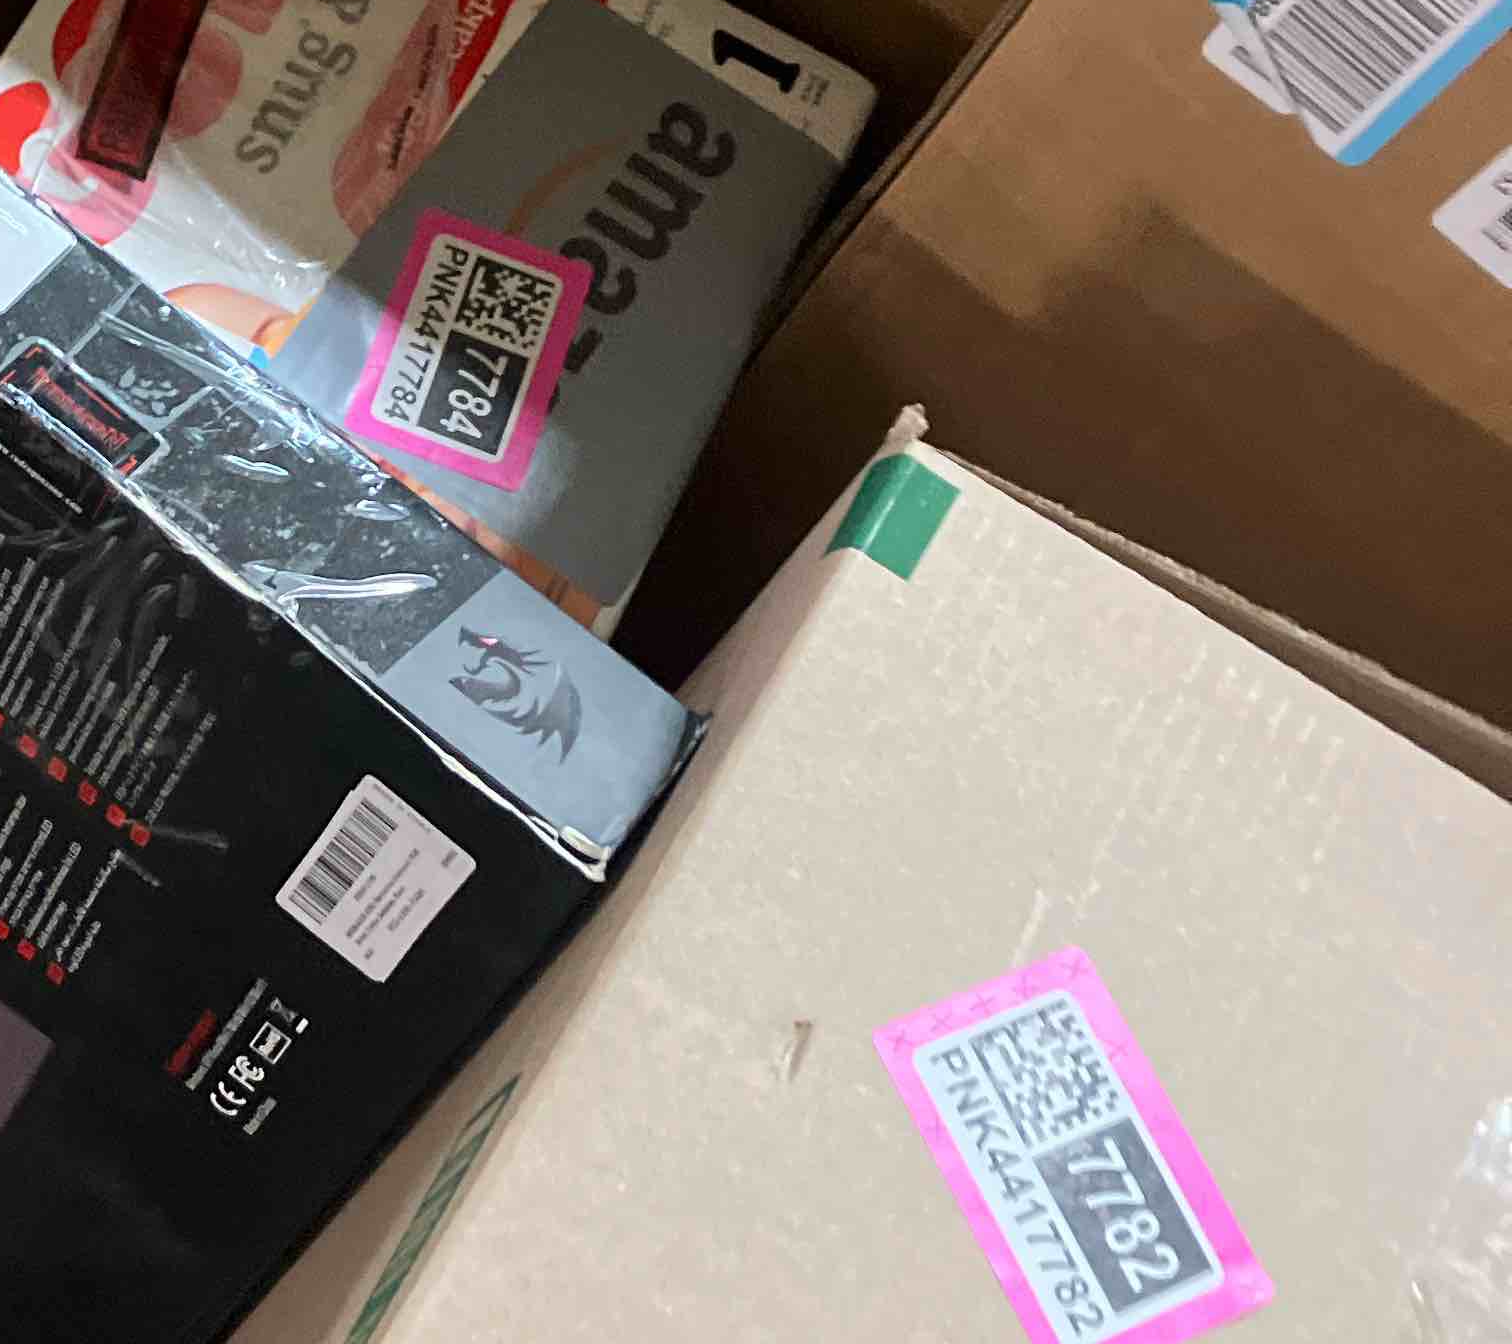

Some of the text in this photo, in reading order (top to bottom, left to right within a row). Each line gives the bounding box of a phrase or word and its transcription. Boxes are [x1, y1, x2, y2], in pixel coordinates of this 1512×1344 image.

[236, 19, 358, 174] snug
[384, 244, 469, 424] PNK4417784
[548, 102, 736, 414] ama
[439, 346, 510, 439] 7784
[929, 1044, 1104, 1337] PNK4417782
[1067, 1136, 1180, 1294] 7782
